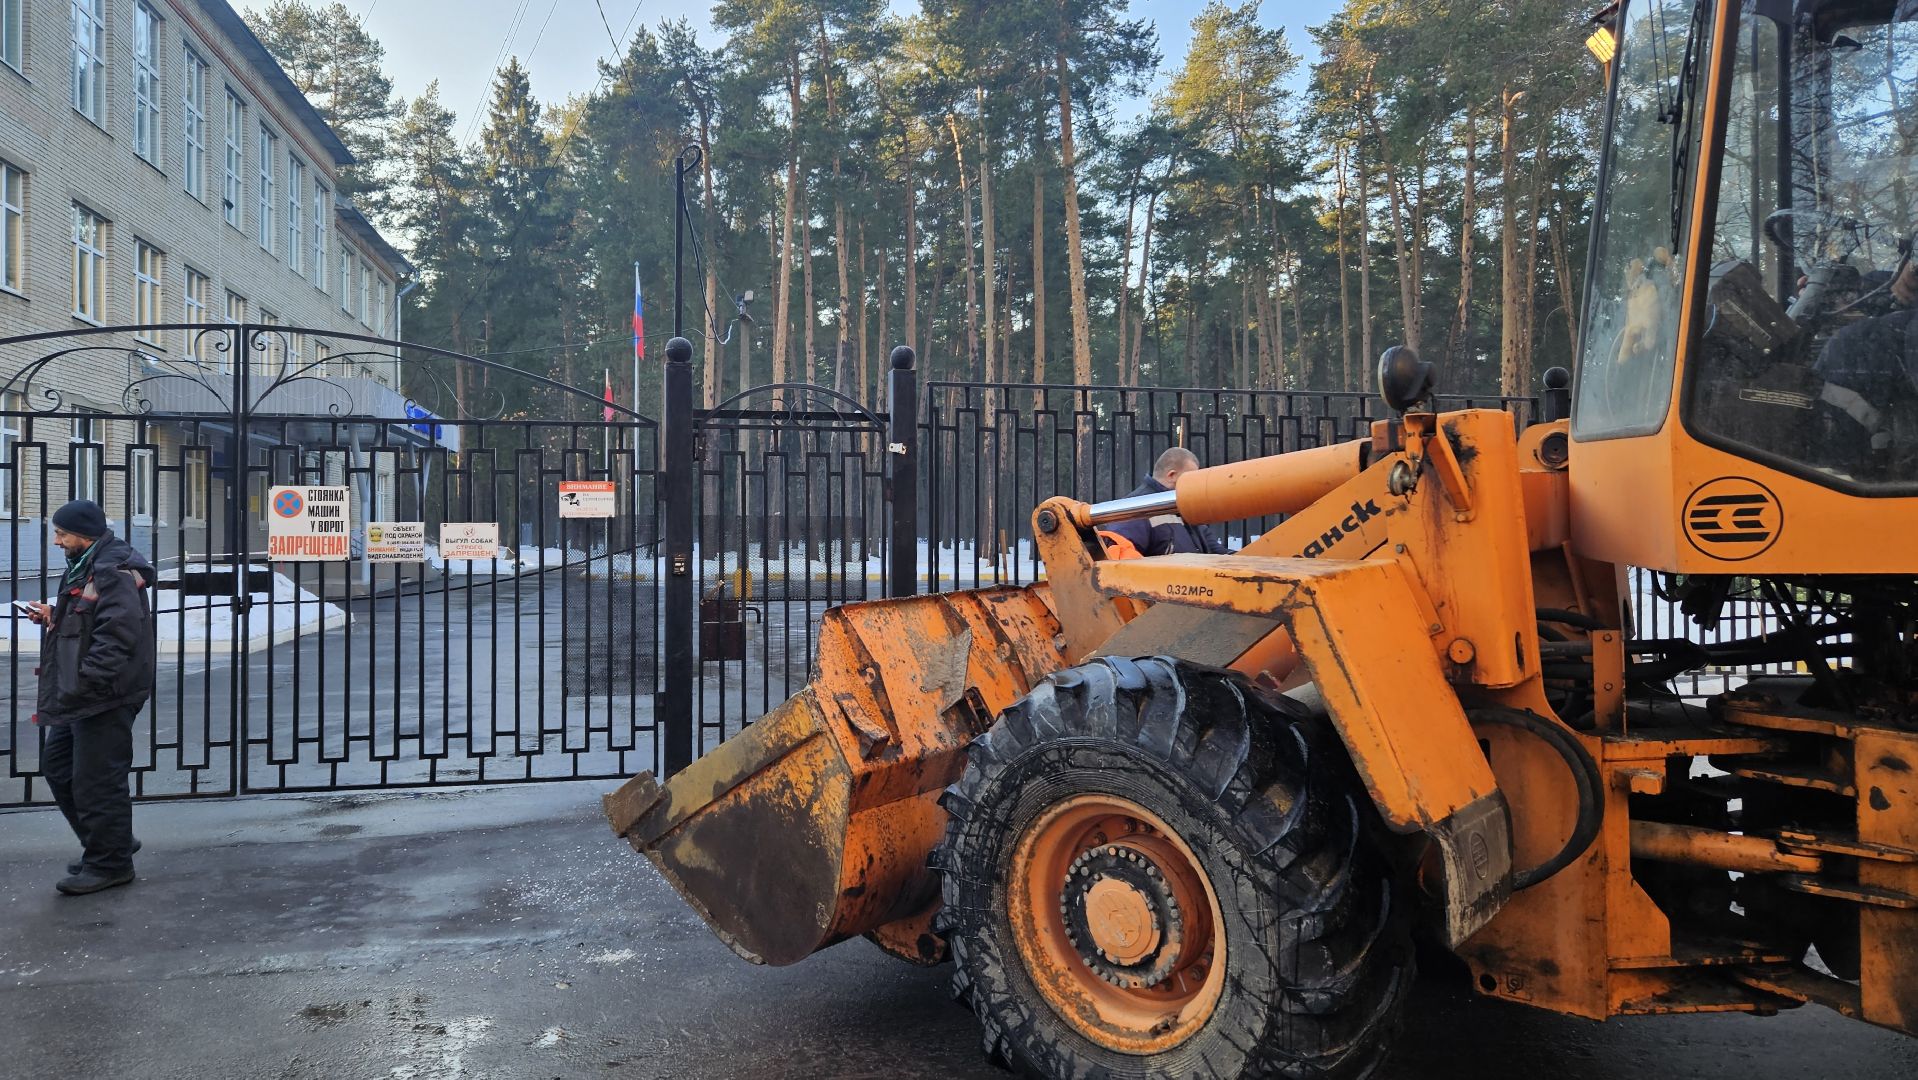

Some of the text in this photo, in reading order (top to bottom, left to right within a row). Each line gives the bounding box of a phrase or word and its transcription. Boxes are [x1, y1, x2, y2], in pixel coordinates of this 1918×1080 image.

[308, 489, 345, 502] СТОЯНКА
[307, 505, 340, 518] МАШИН
[310, 520, 345, 533] У ВОРОТ
[1292, 498, 1382, 559] янск
[384, 531, 423, 540] ПОД ОХРАНОЙ
[269, 535, 348, 558] ЗАПРЕЩЕНА!
